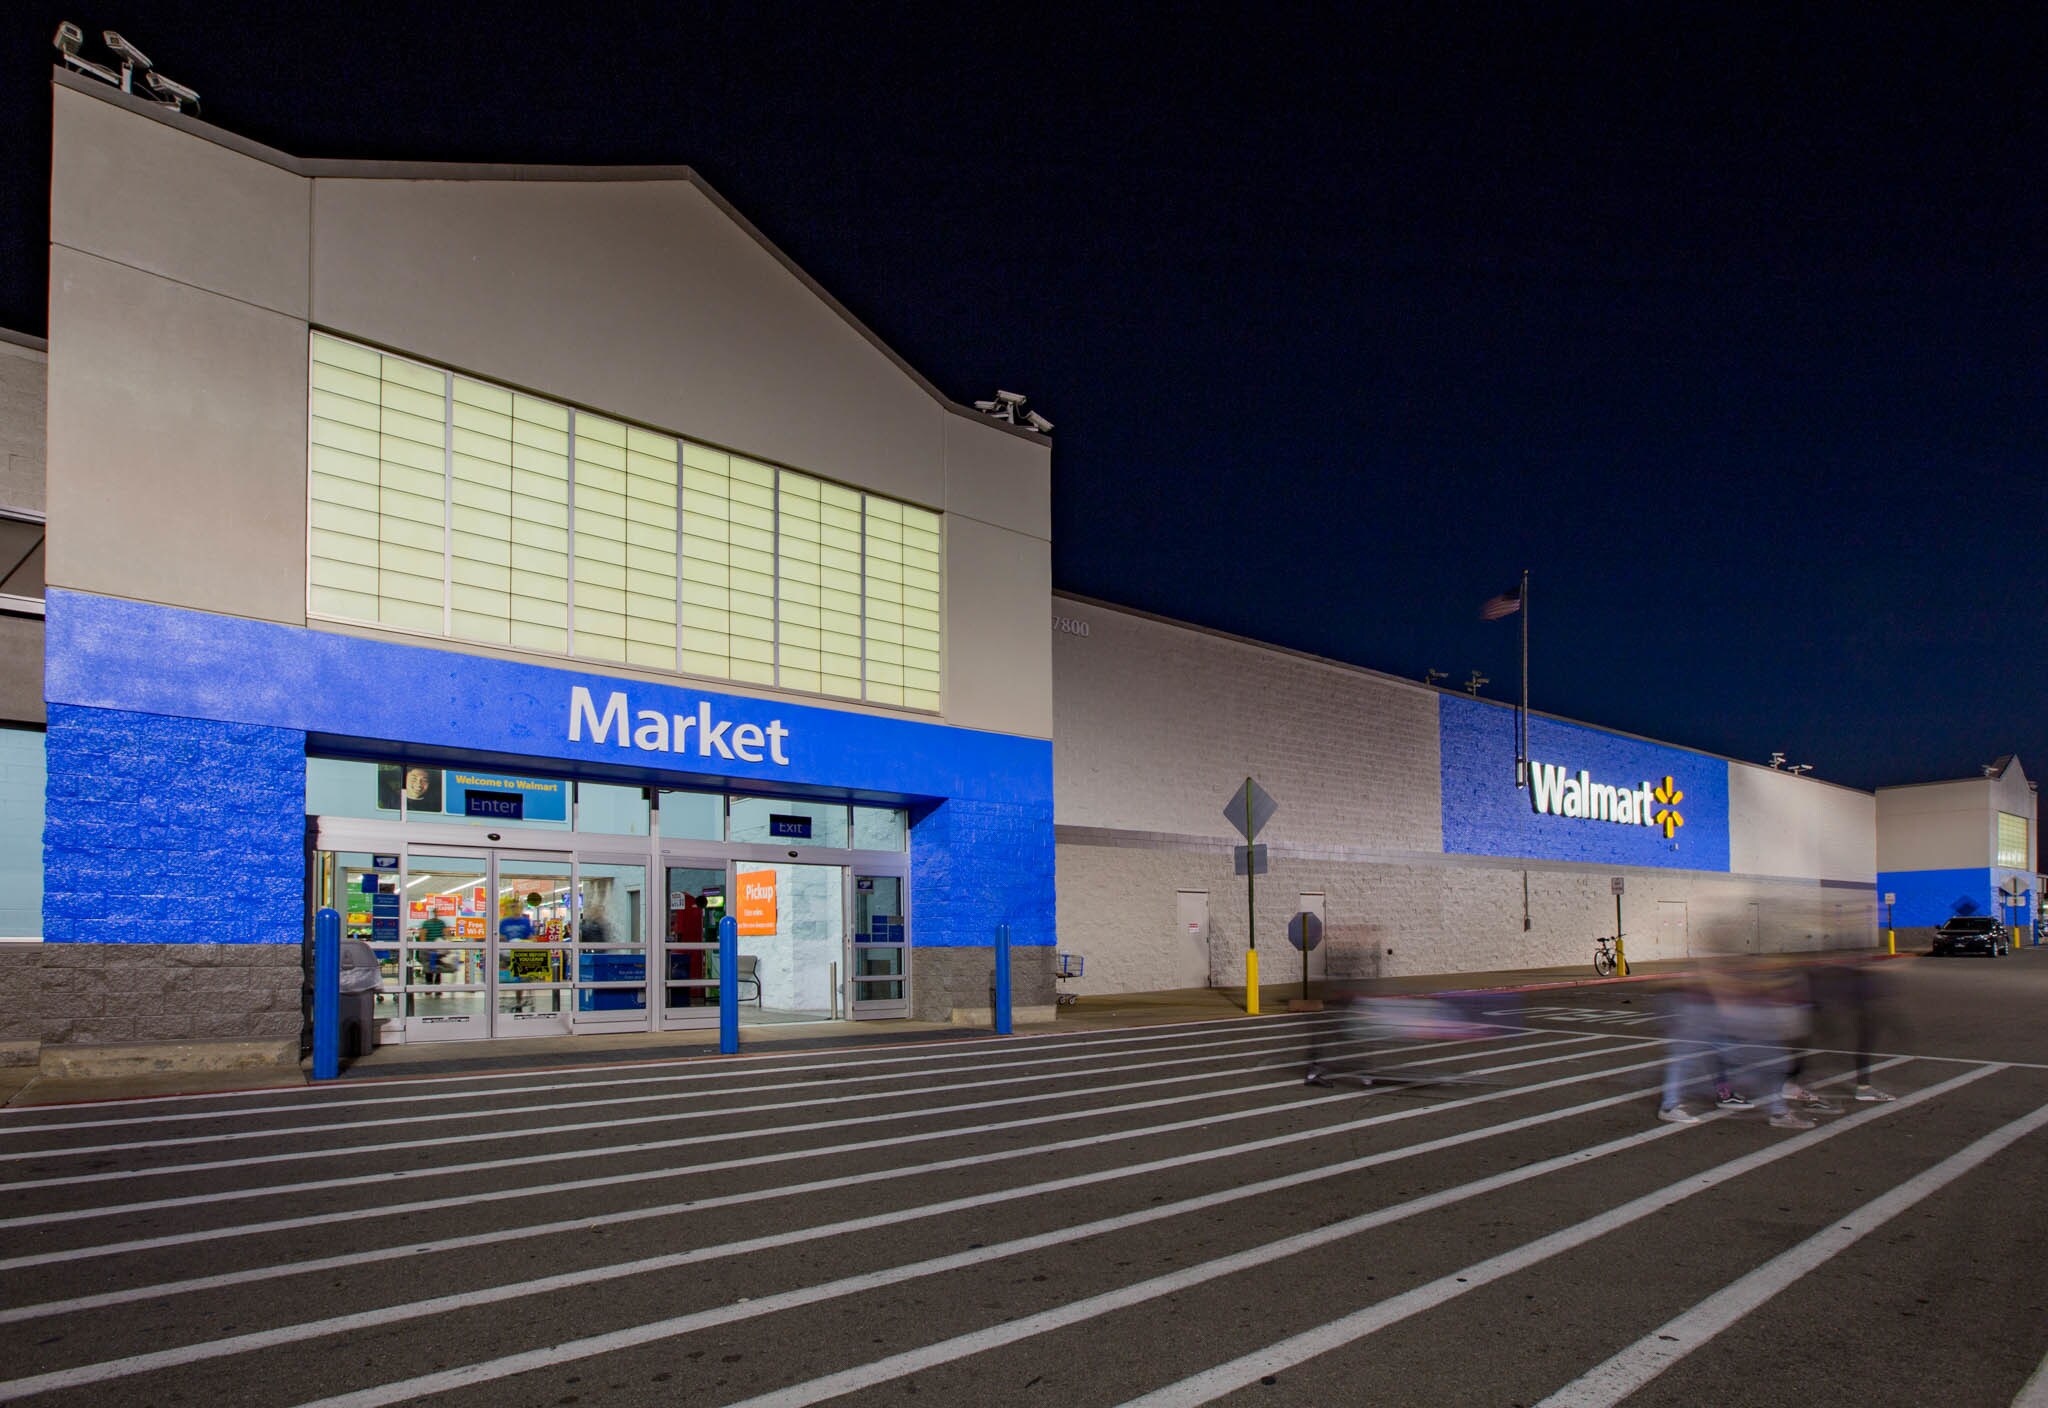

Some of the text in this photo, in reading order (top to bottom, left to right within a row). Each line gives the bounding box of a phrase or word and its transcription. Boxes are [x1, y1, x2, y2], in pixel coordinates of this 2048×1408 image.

[568, 685, 789, 765] Market
[456, 774, 558, 792] Welcome to Walmart
[1530, 760, 1654, 826] Walmart
[471, 797, 517, 814] Enter
[746, 883, 774, 903] Pickup
